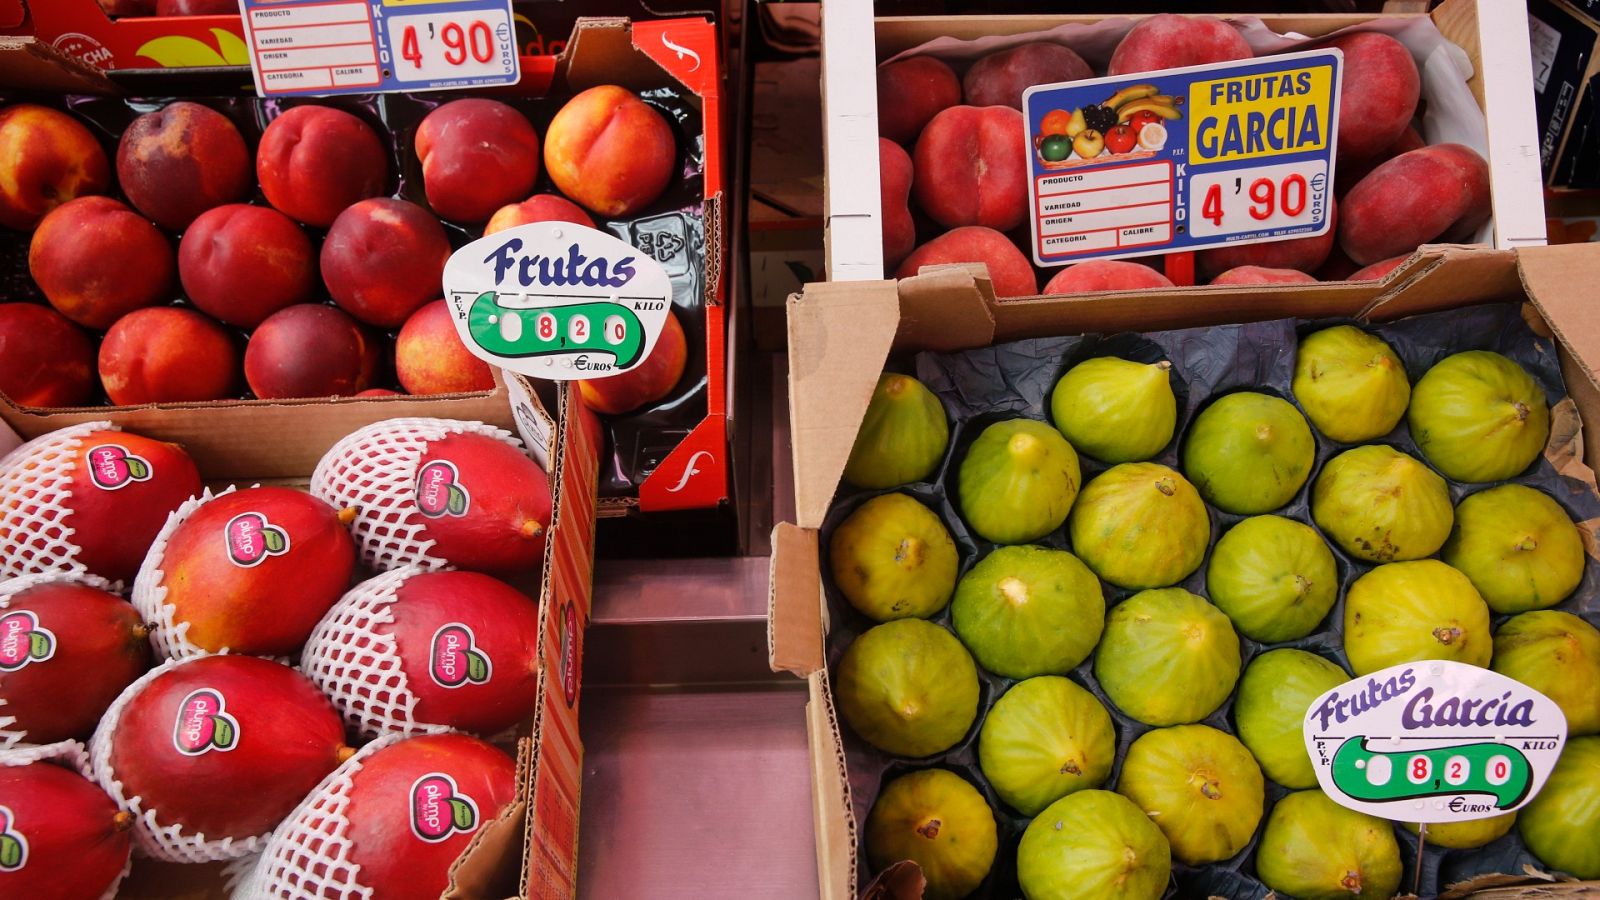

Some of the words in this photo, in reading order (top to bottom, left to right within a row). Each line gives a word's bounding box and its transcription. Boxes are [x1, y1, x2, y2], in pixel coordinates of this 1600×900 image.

[255, 10, 291, 18] PRODUCTO
[372, 4, 390, 64] KILO
[260, 37, 293, 45] VARIEDAD
[263, 52, 288, 60] ORIGEN
[267, 72, 304, 80] CATEGORIA
[1210, 72, 1312, 106] FRUTAS
[1196, 105, 1321, 159] GARCIA
[1042, 175, 1084, 185] PRODUCTO
[1175, 163, 1187, 221] KILO
[1044, 202, 1081, 211] VARIEDAD
[1045, 217, 1073, 225] ORIGEN
[1123, 227, 1154, 236] CALIBRE
[1046, 235, 1087, 245] CATEGORIA
[484, 238, 637, 287] Frutas
[634, 301, 664, 311] KILO
[442, 635, 460, 676] plump
[1310, 668, 1416, 732] Frutas
[1401, 686, 1538, 730] García
[188, 700, 208, 741] plump
[1522, 741, 1558, 750] KILO
[424, 785, 442, 828] plump
